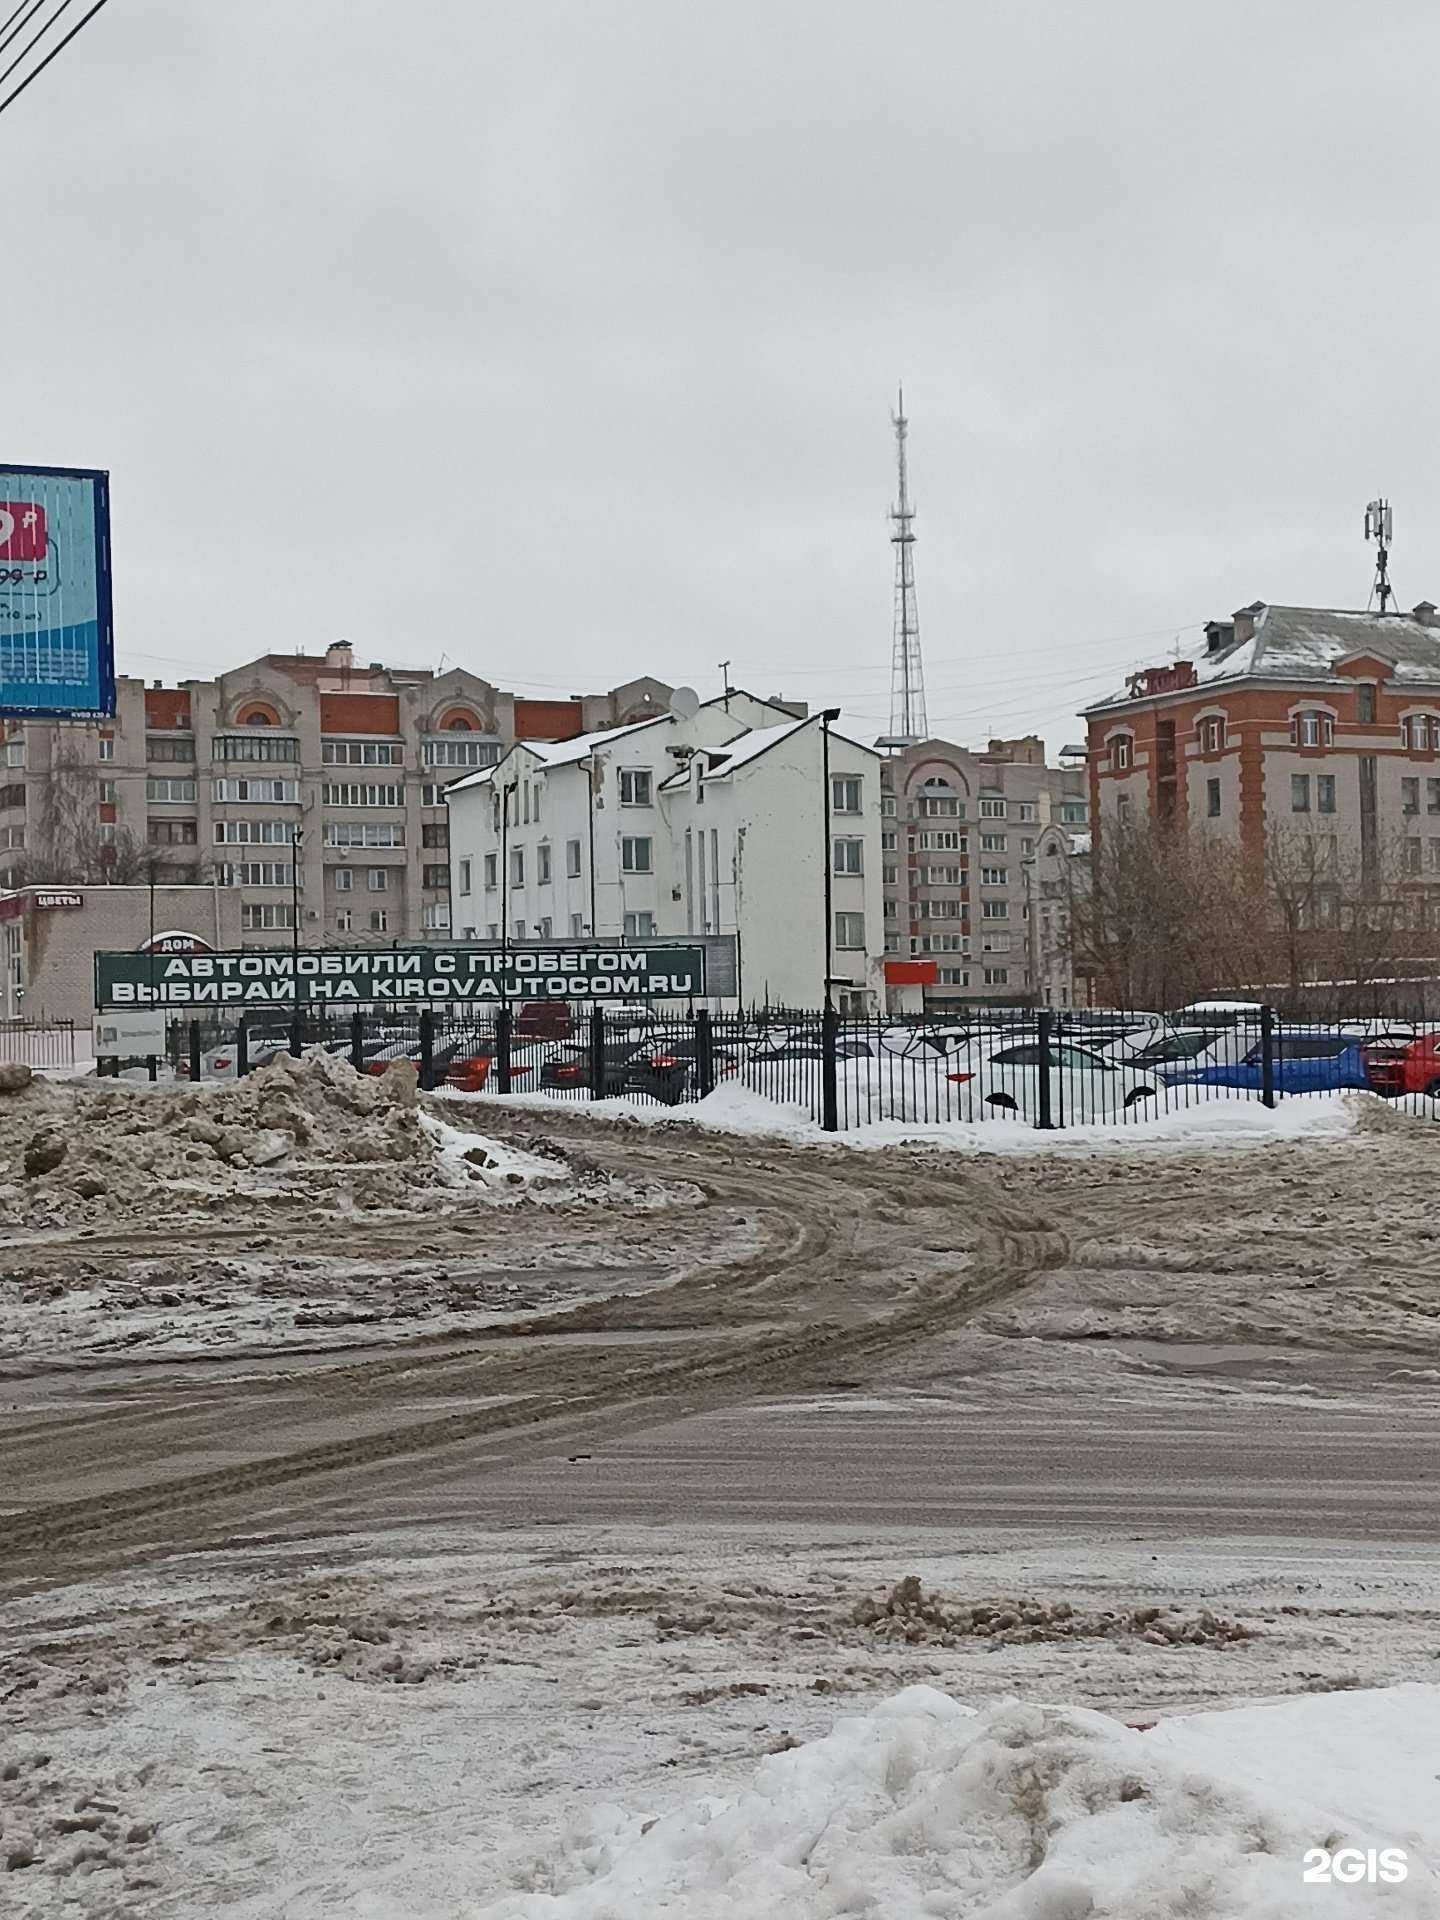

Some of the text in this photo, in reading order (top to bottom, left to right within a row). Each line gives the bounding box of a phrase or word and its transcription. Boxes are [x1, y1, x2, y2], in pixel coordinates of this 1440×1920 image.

[38, 896, 81, 906] ЦВЕТЫ
[161, 939, 195, 952] ДОМ
[164, 952, 648, 976] АВТОМОБИЛИ С ПРОБЕГОМ
[111, 974, 692, 1001] ВЫБИРАЙ НА KIROVAUTOCOM.RU
